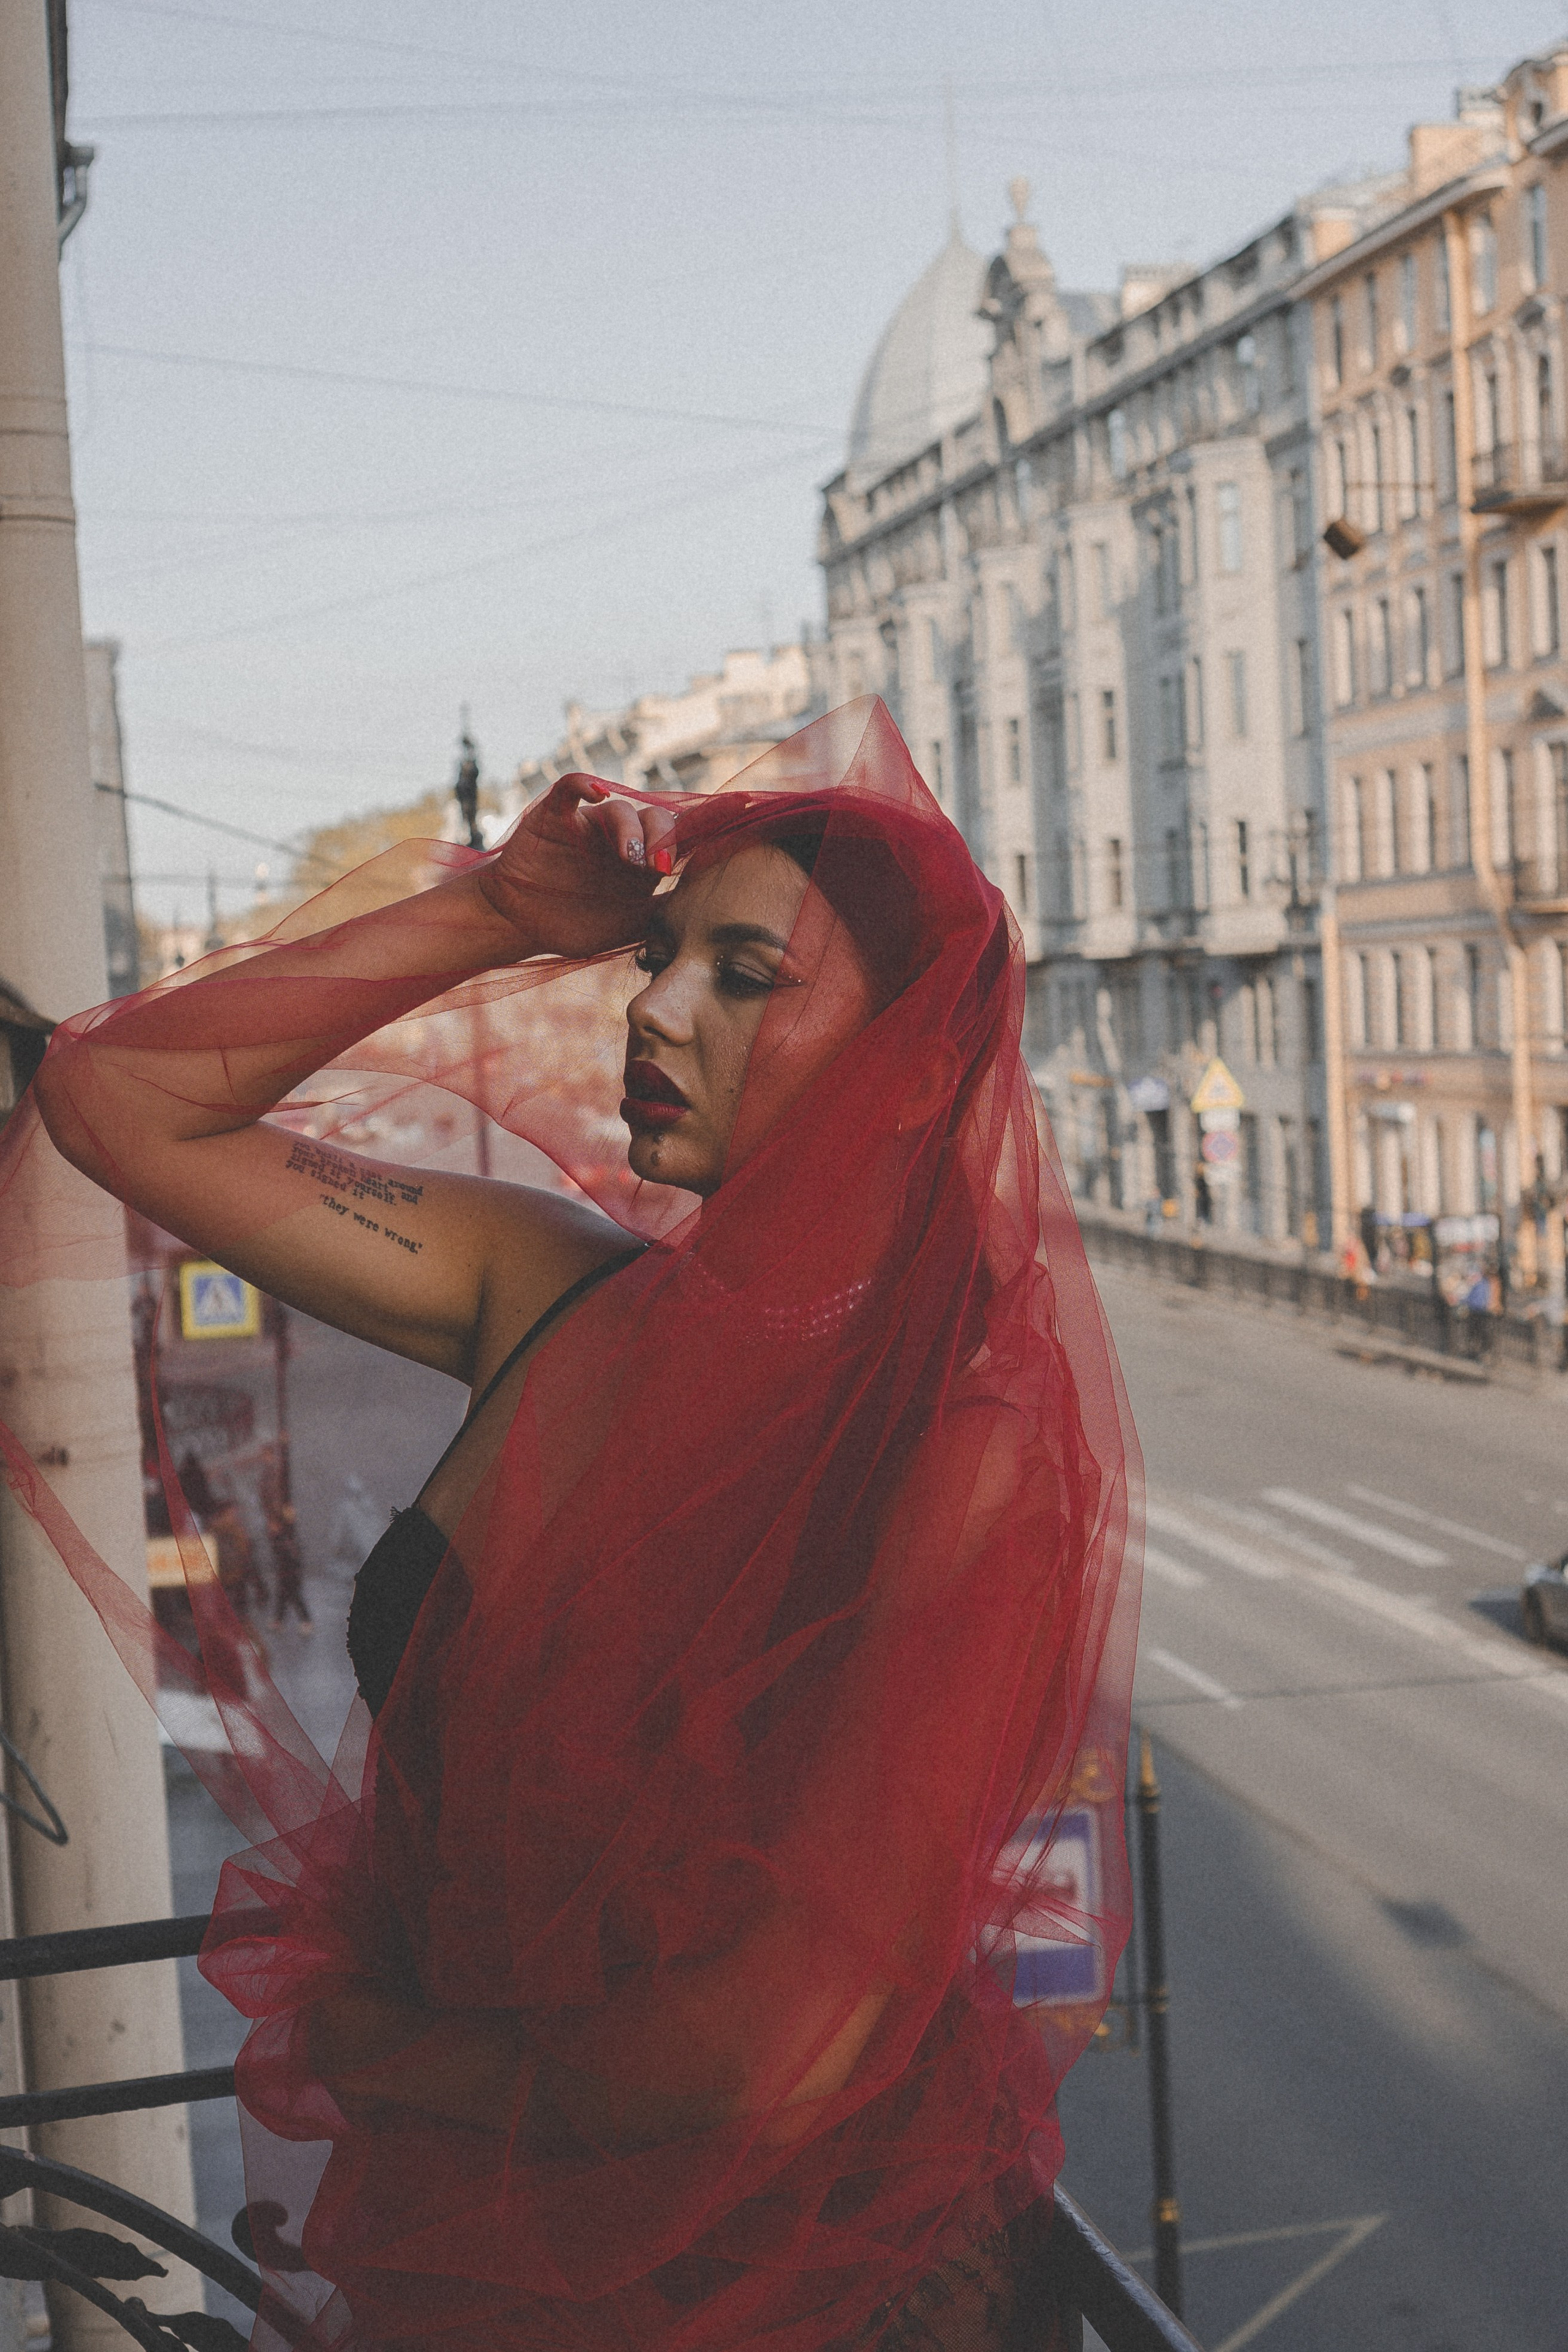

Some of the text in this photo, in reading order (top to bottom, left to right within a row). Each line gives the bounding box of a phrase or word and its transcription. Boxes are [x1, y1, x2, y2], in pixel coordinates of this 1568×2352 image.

[311, 1169, 347, 1192] signed
[353, 1188, 364, 1200] it
[401, 1191, 418, 1205] and
[353, 1212, 380, 1232] were
